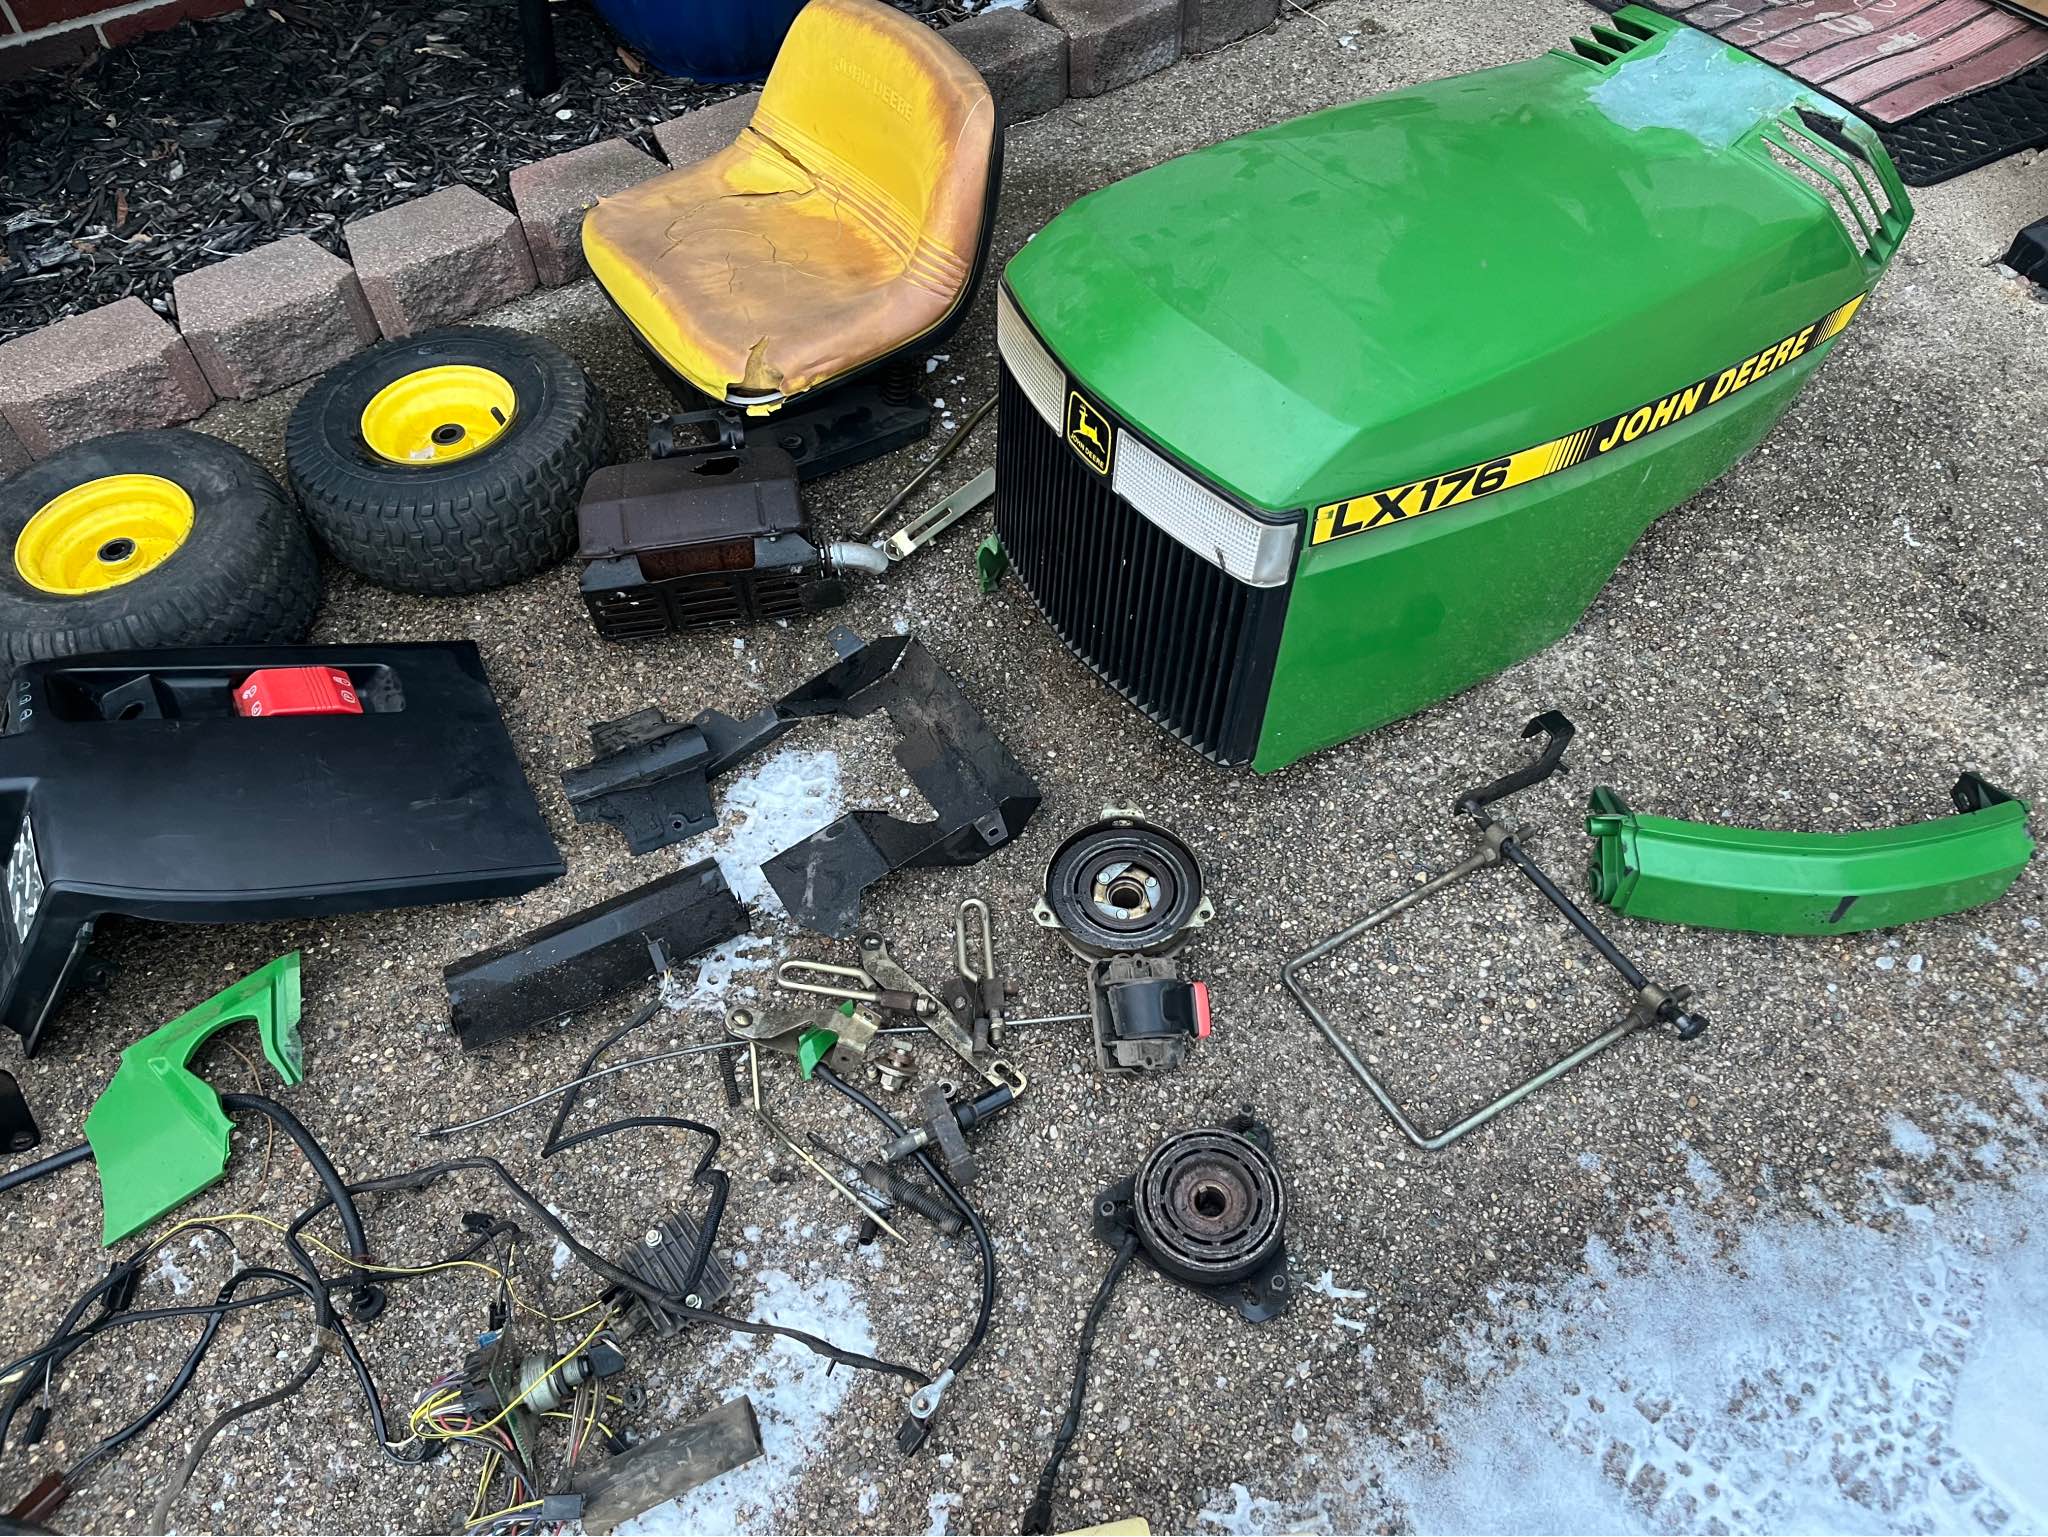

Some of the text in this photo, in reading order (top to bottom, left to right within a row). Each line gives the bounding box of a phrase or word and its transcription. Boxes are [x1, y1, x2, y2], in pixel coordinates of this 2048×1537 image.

[872, 77, 912, 124] DEERE
[1599, 324, 1816, 452] JOHN DEERE
[1070, 433, 1105, 469] JOHN DEERE
[1330, 458, 1512, 538] LX176
